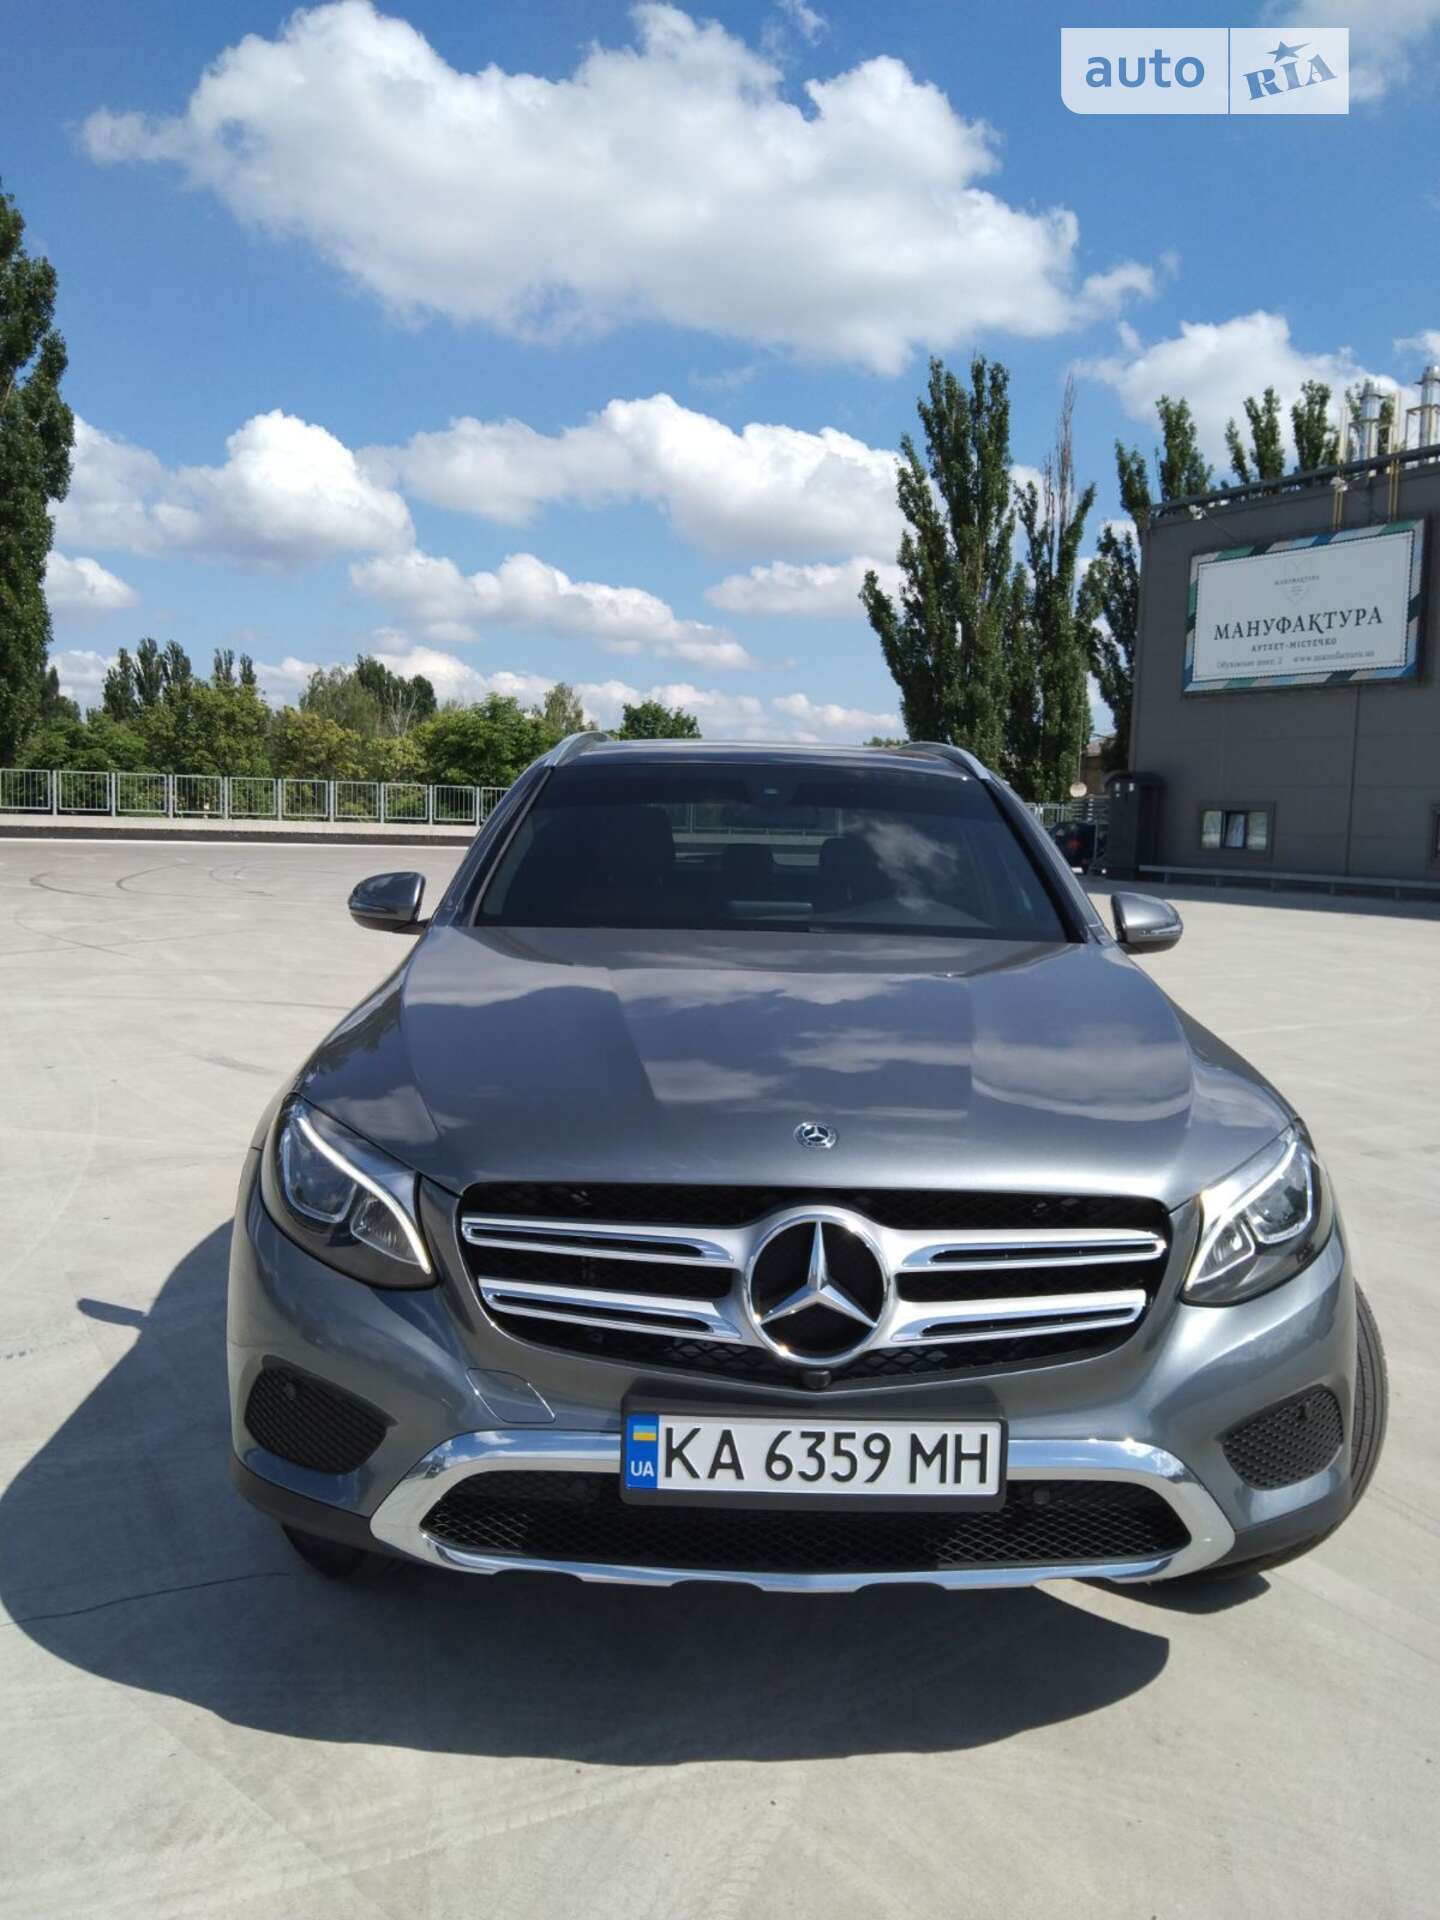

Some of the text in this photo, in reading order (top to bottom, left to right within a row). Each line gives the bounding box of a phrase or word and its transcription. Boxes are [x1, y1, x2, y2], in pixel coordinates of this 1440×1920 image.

[1213, 605, 1383, 641] МАНУФАКТУРА
[630, 1461, 655, 1478] UA
[664, 1427, 988, 1484] KA 6359 MH
